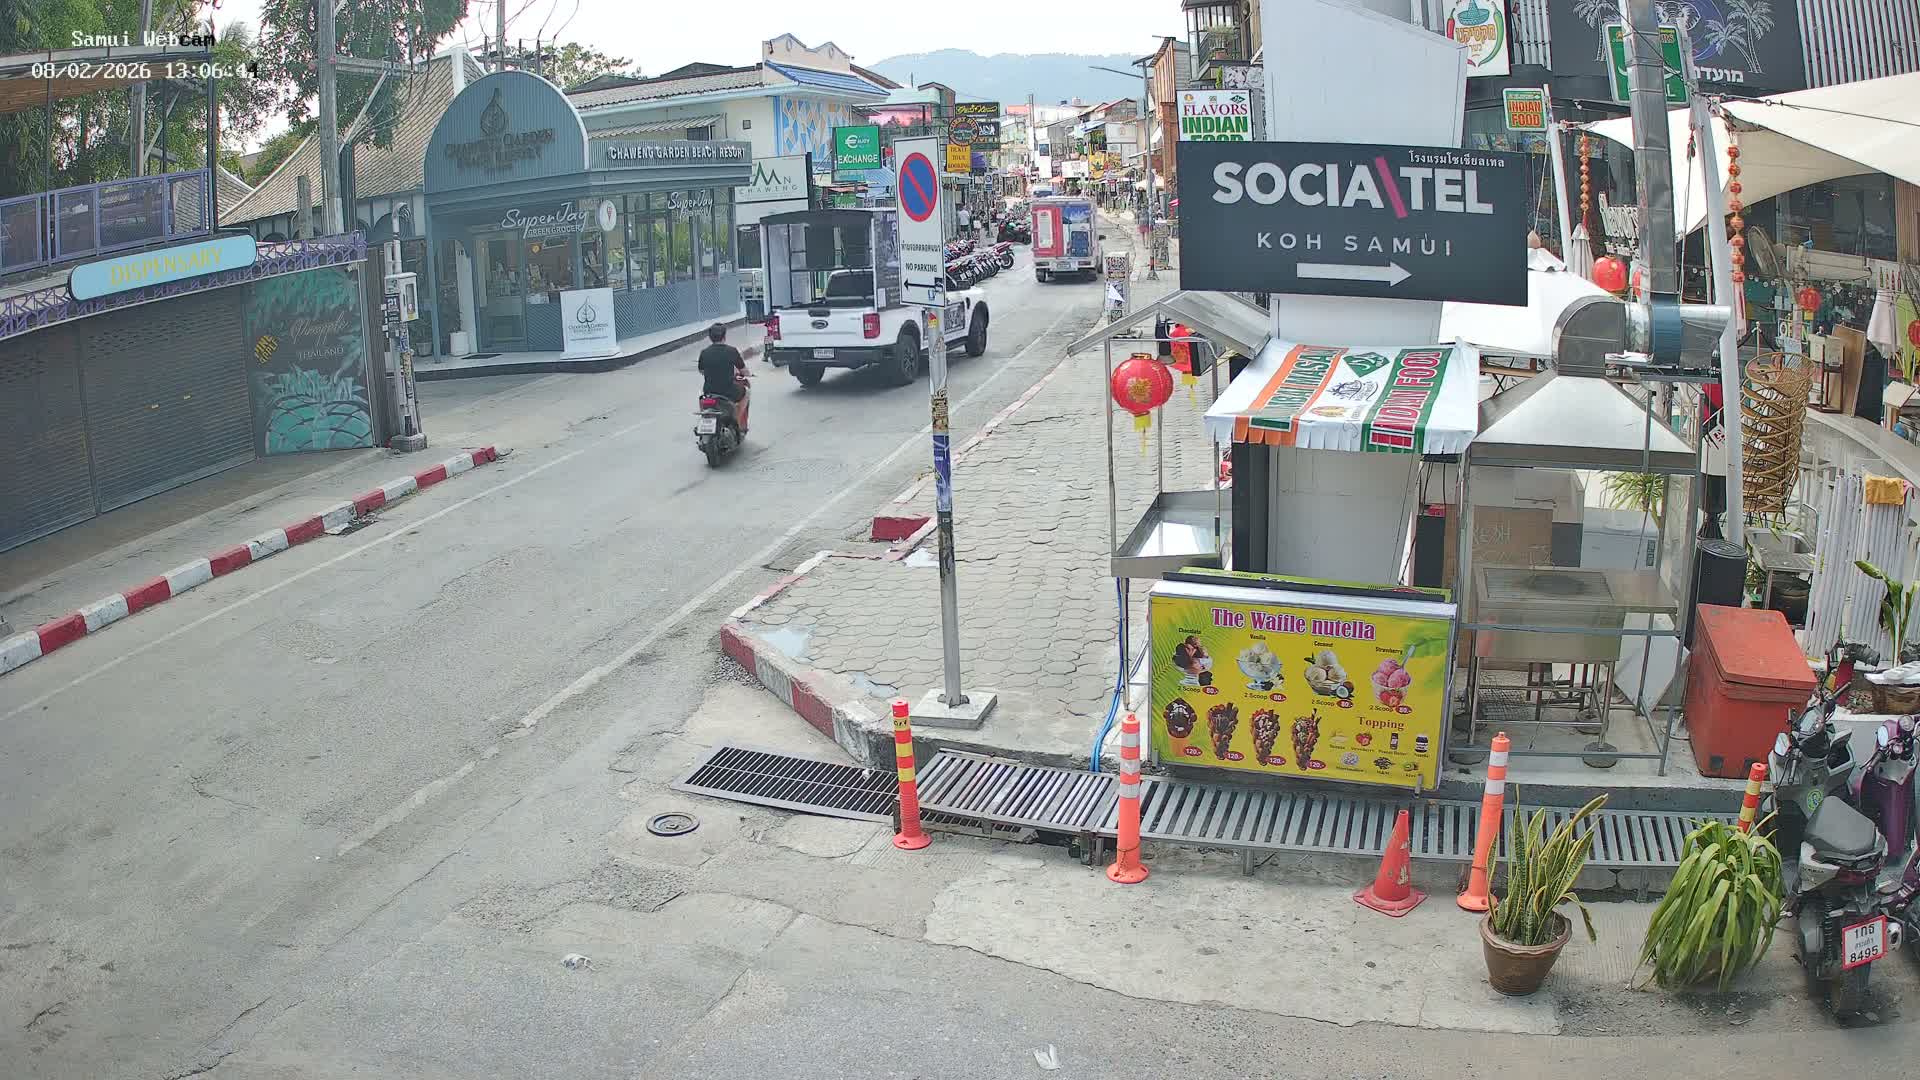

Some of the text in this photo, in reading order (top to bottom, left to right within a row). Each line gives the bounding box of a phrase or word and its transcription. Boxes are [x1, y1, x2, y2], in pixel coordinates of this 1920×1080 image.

[1184, 103, 1248, 116] FLAVORS
[1508, 101, 1542, 113] INDIAN
[1182, 116, 1249, 134] INDIAN
[1512, 114, 1541, 126] FOOD
[608, 146, 745, 160] CHAWENG GARDEN BEACH RESORT
[838, 154, 878, 164] EXCHANGE
[739, 184, 798, 195] CHAWENG
[501, 202, 590, 239] SuperJay
[528, 225, 581, 236] GREEN GROCER
[1257, 232, 1451, 257] KOH SAMUI
[111, 247, 223, 287] DISPENSARY
[906, 262, 938, 273] NO PARKING
[297, 345, 344, 359] THAILAND
[1393, 351, 1443, 382] FOOD
[1211, 607, 1377, 641] The Waffle nutella
[1249, 693, 1268, 701] Scoop
[1316, 699, 1335, 707] Scoop
[1375, 705, 1394, 713] Scoop
[1359, 716, 1404, 731] Topping
[1850, 945, 1879, 963] 8495
